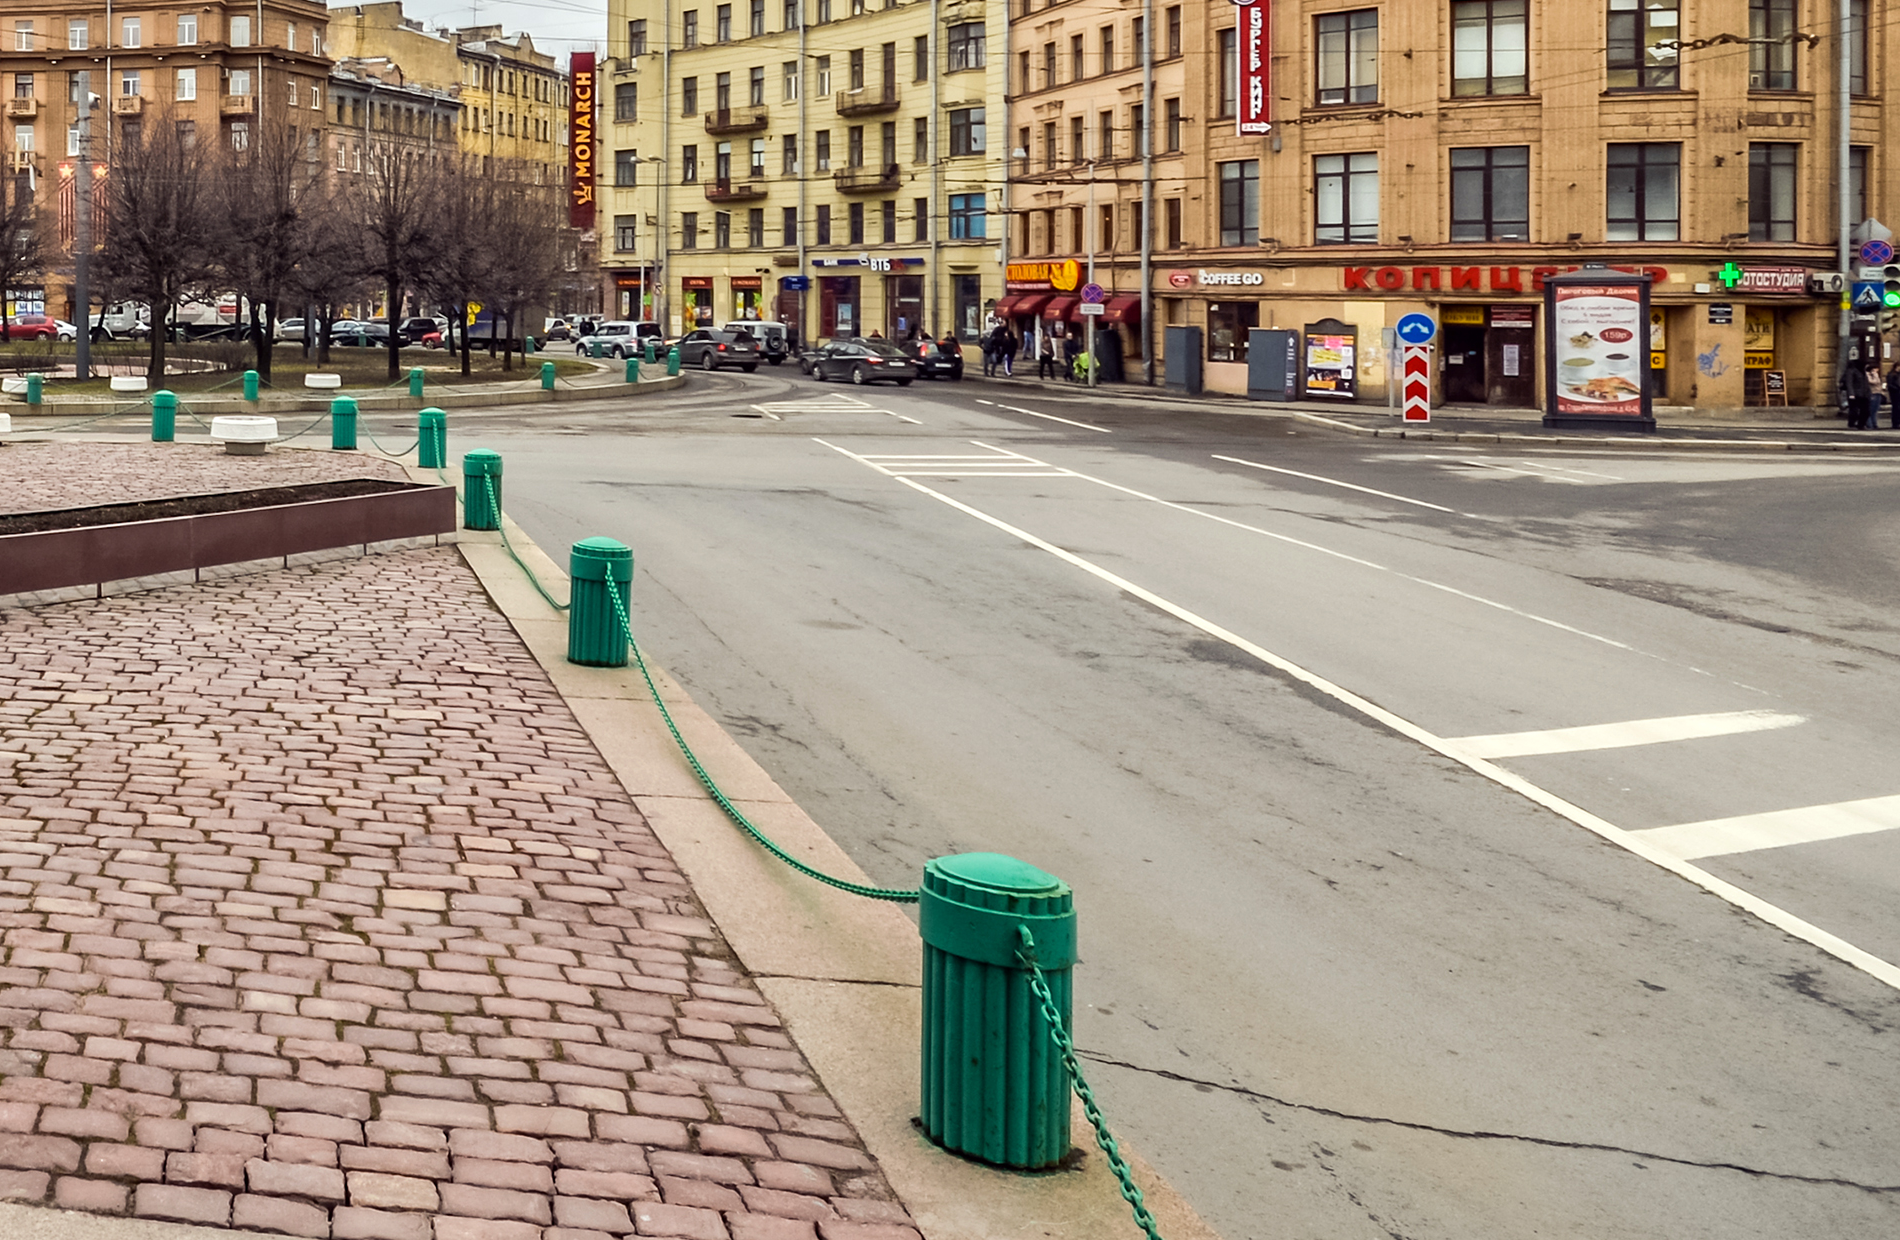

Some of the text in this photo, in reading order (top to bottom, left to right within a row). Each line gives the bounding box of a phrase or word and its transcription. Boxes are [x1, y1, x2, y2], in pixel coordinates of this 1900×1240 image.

[1249, 7, 1262, 72] БУРГЕР
[1249, 75, 1263, 120] КИНГ
[575, 72, 592, 178] MONARCH
[1006, 263, 1049, 281] СТОЛОВАЯ
[1200, 272, 1242, 285] COFFEE
[1242, 272, 1263, 285] GO
[1344, 266, 1668, 293] КОПИЦЕР
